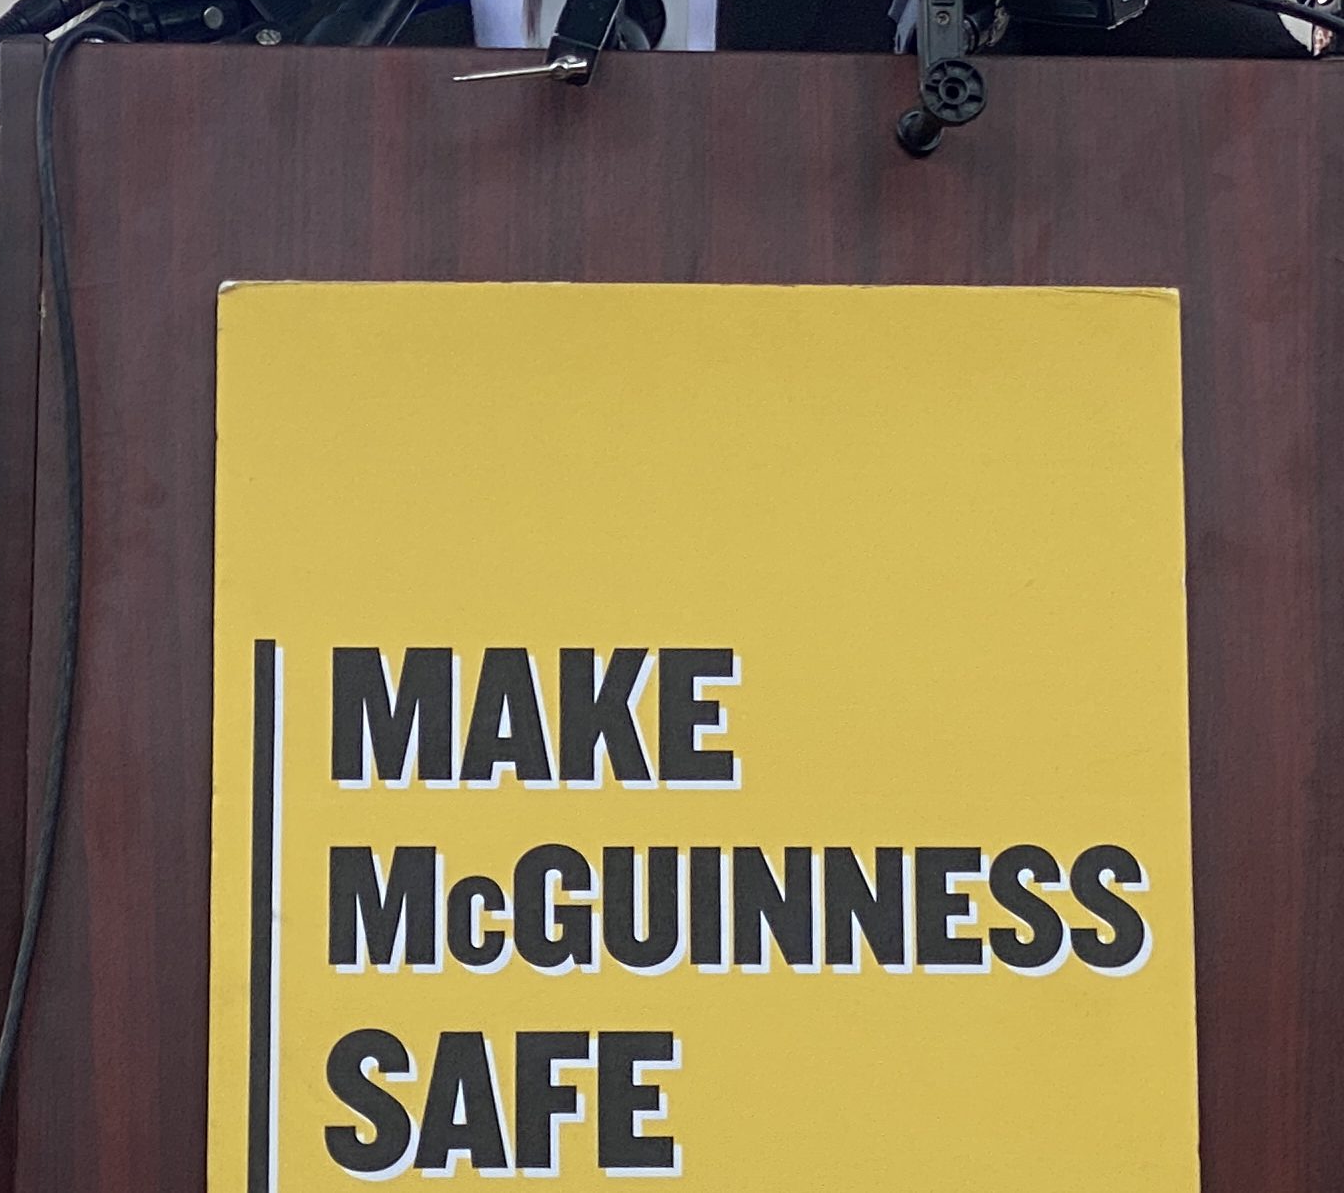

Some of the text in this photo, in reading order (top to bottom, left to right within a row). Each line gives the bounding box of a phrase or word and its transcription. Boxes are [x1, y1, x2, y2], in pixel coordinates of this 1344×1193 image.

[331, 647, 740, 788] MAKE
[328, 844, 1150, 974] McGUINNESS
[323, 1028, 681, 1179] SAFE
